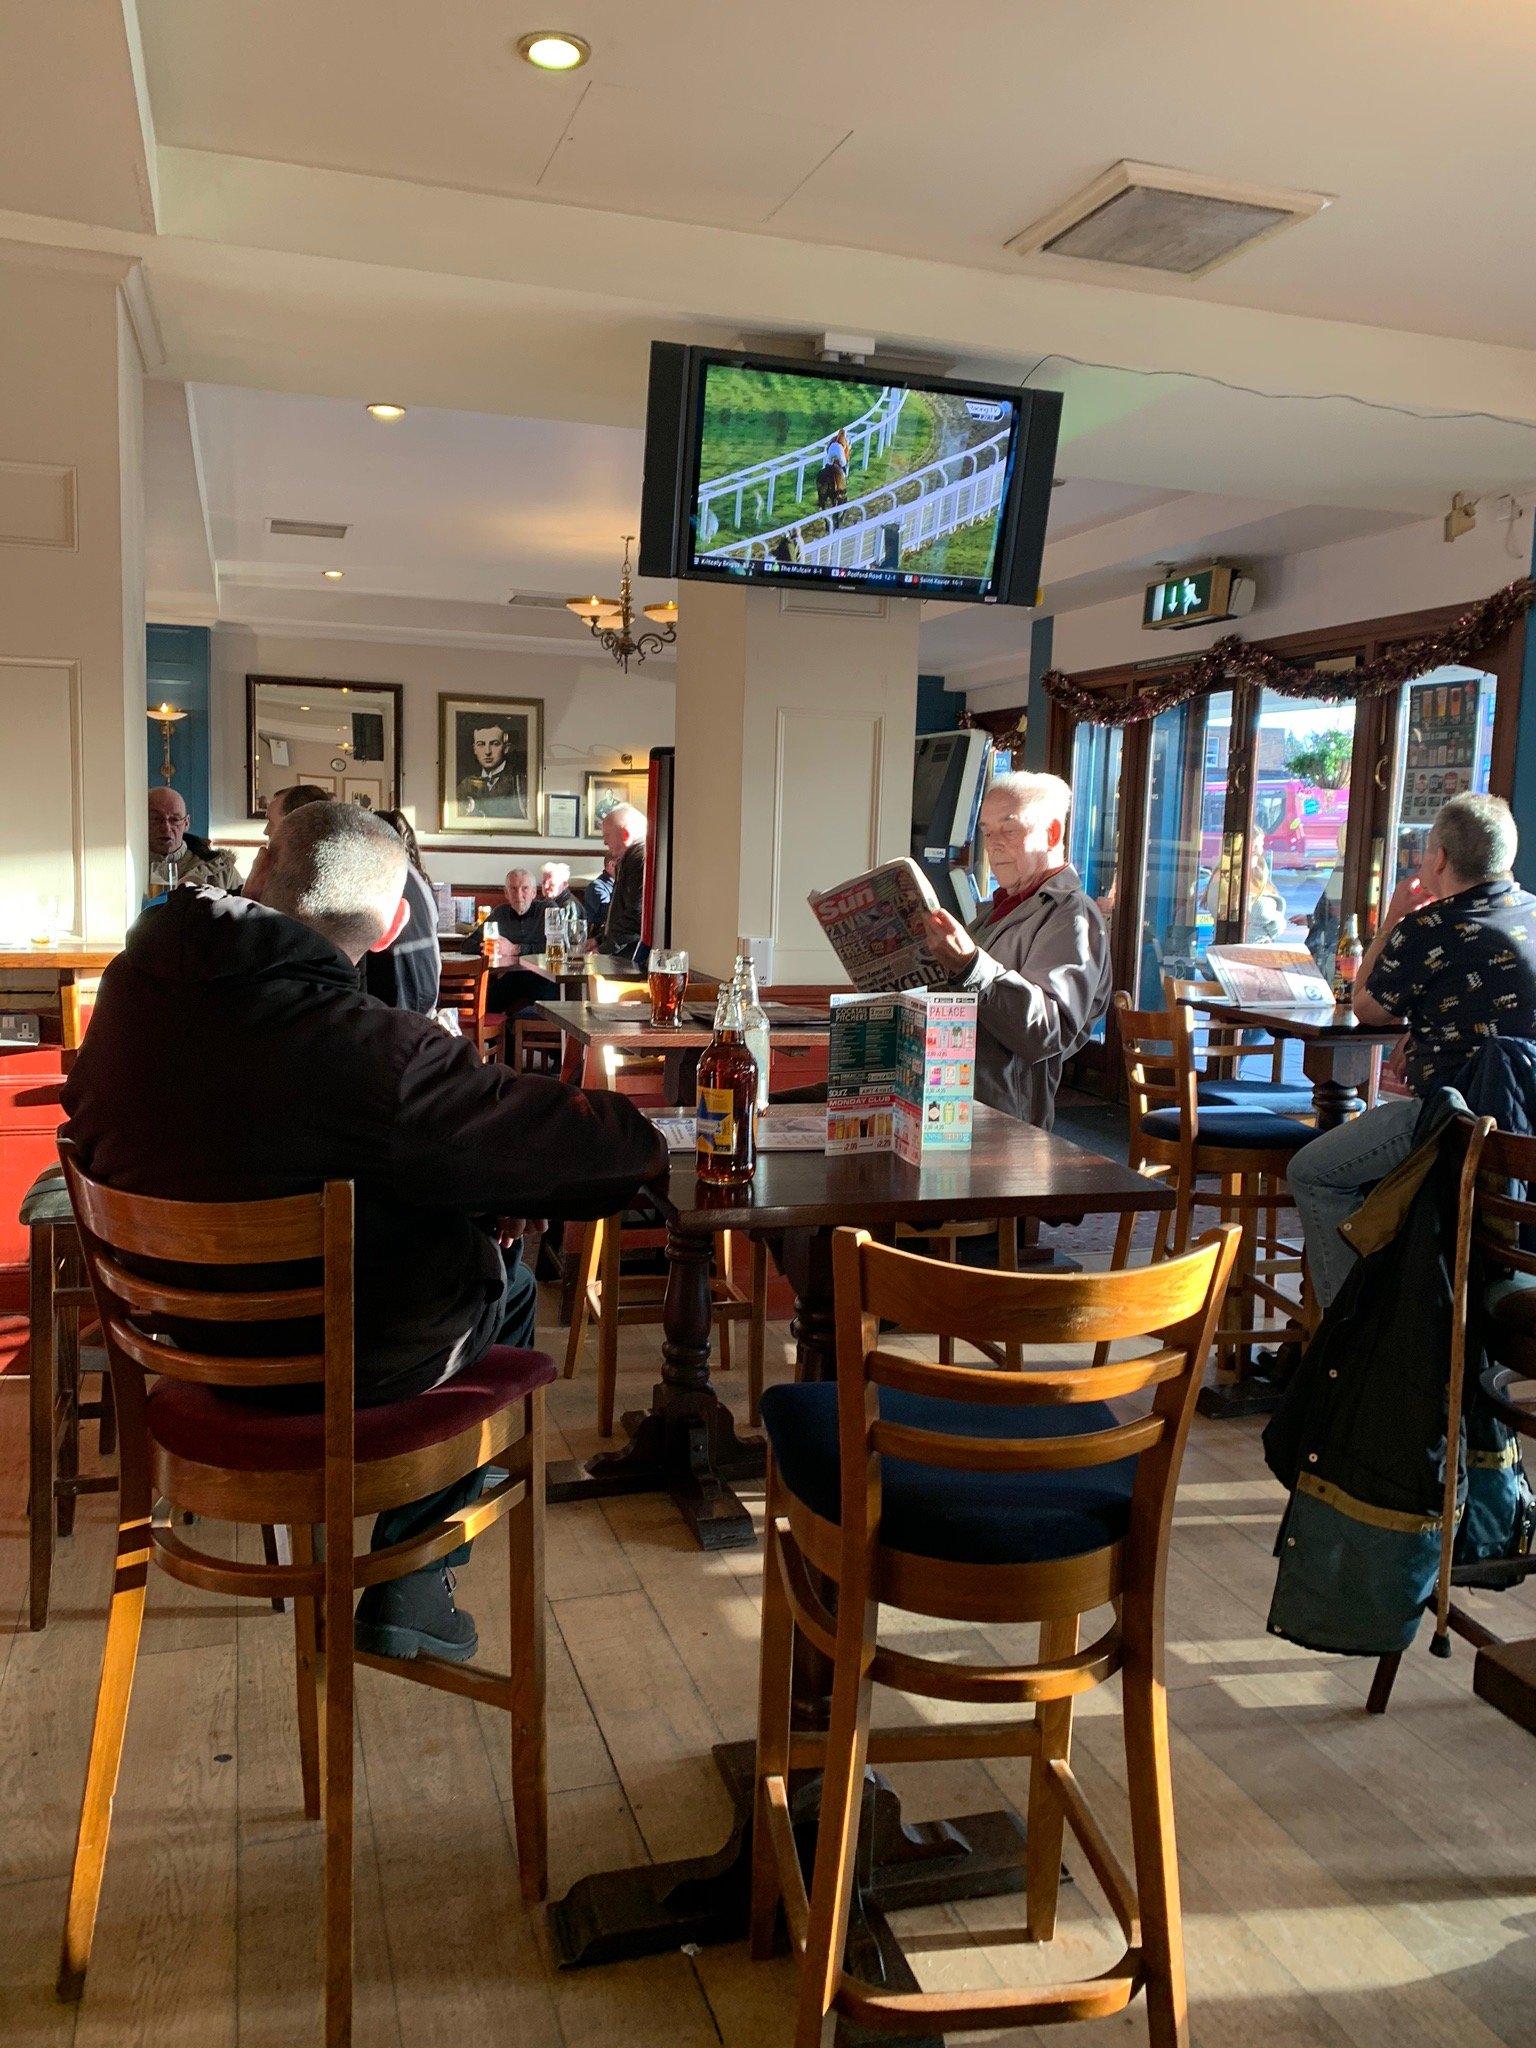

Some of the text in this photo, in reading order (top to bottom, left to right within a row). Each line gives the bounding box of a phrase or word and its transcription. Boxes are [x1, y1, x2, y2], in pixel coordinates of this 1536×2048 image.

[818, 886, 876, 920] Sun
[930, 1006, 966, 1017] PALACE
[829, 1095, 891, 1107] MONDAY CLUB
